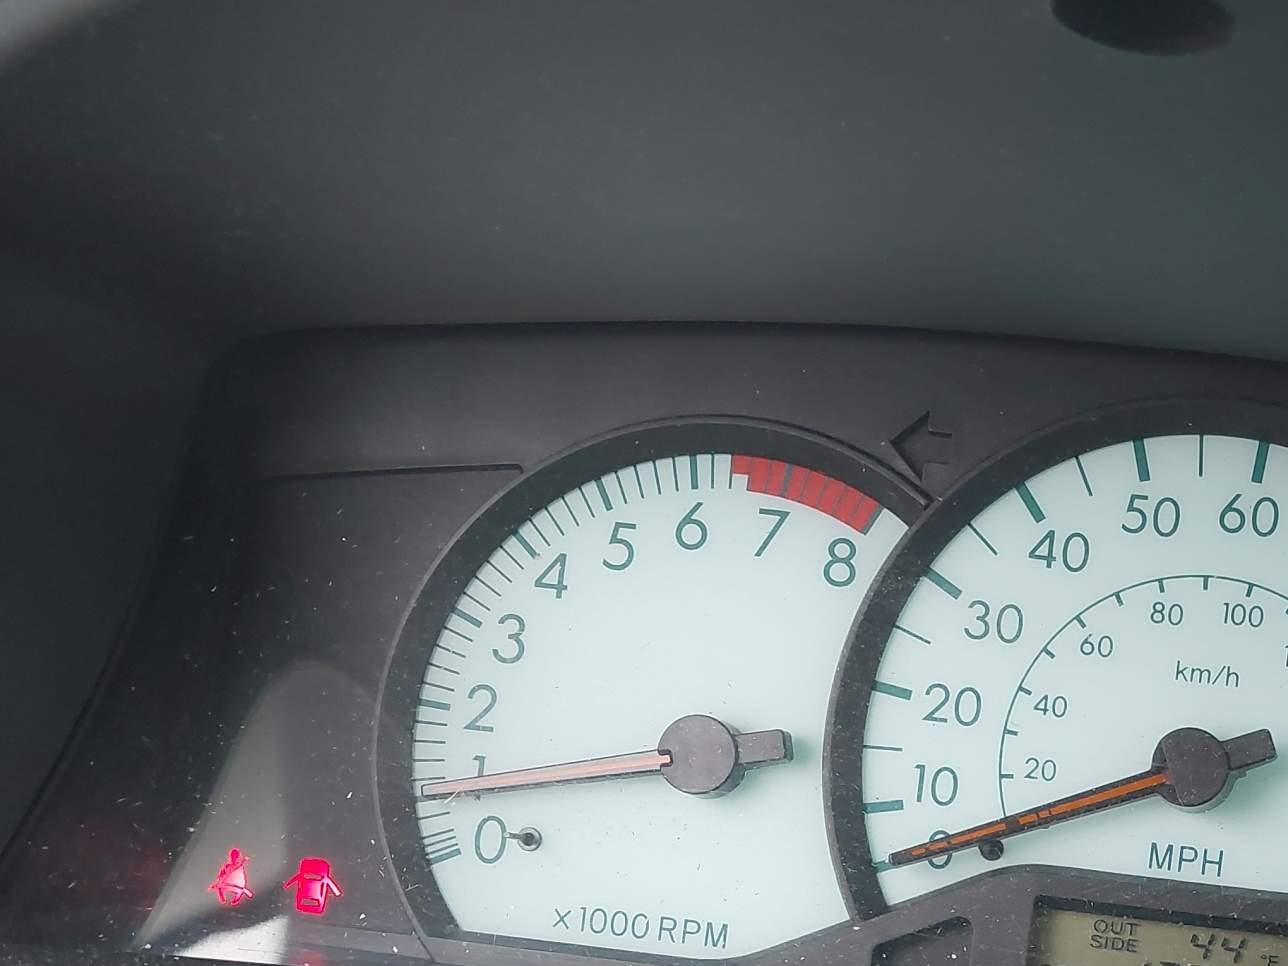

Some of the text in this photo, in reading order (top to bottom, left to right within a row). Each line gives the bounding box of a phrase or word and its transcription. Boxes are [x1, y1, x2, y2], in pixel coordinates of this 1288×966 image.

[675, 502, 708, 550] 6
[754, 508, 791, 557] 7
[1120, 495, 1181, 538] 50
[1219, 495, 1280, 538] 60
[602, 522, 637, 571] 5
[823, 537, 857, 587] 8
[1027, 530, 1090, 573] 40
[534, 553, 569, 599] 4
[963, 600, 1024, 644] 30
[1149, 602, 1184, 626] 80
[1221, 602, 1265, 629] 100
[492, 613, 526, 664] 3
[1079, 634, 1114, 659] 60
[1174, 659, 1240, 689] km/h
[463, 684, 498, 733] 2
[922, 682, 982, 728] 20
[1033, 695, 1068, 719] 40
[914, 764, 959, 807] 10
[1025, 758, 1058, 782] 20
[474, 815, 507, 864] 0
[1147, 841, 1225, 878] MPH
[658, 917, 729, 949] RPM
[1090, 934, 1139, 953] SIDE
[1093, 919, 1140, 937] OUT
[1190, 933, 1248, 964] 44
